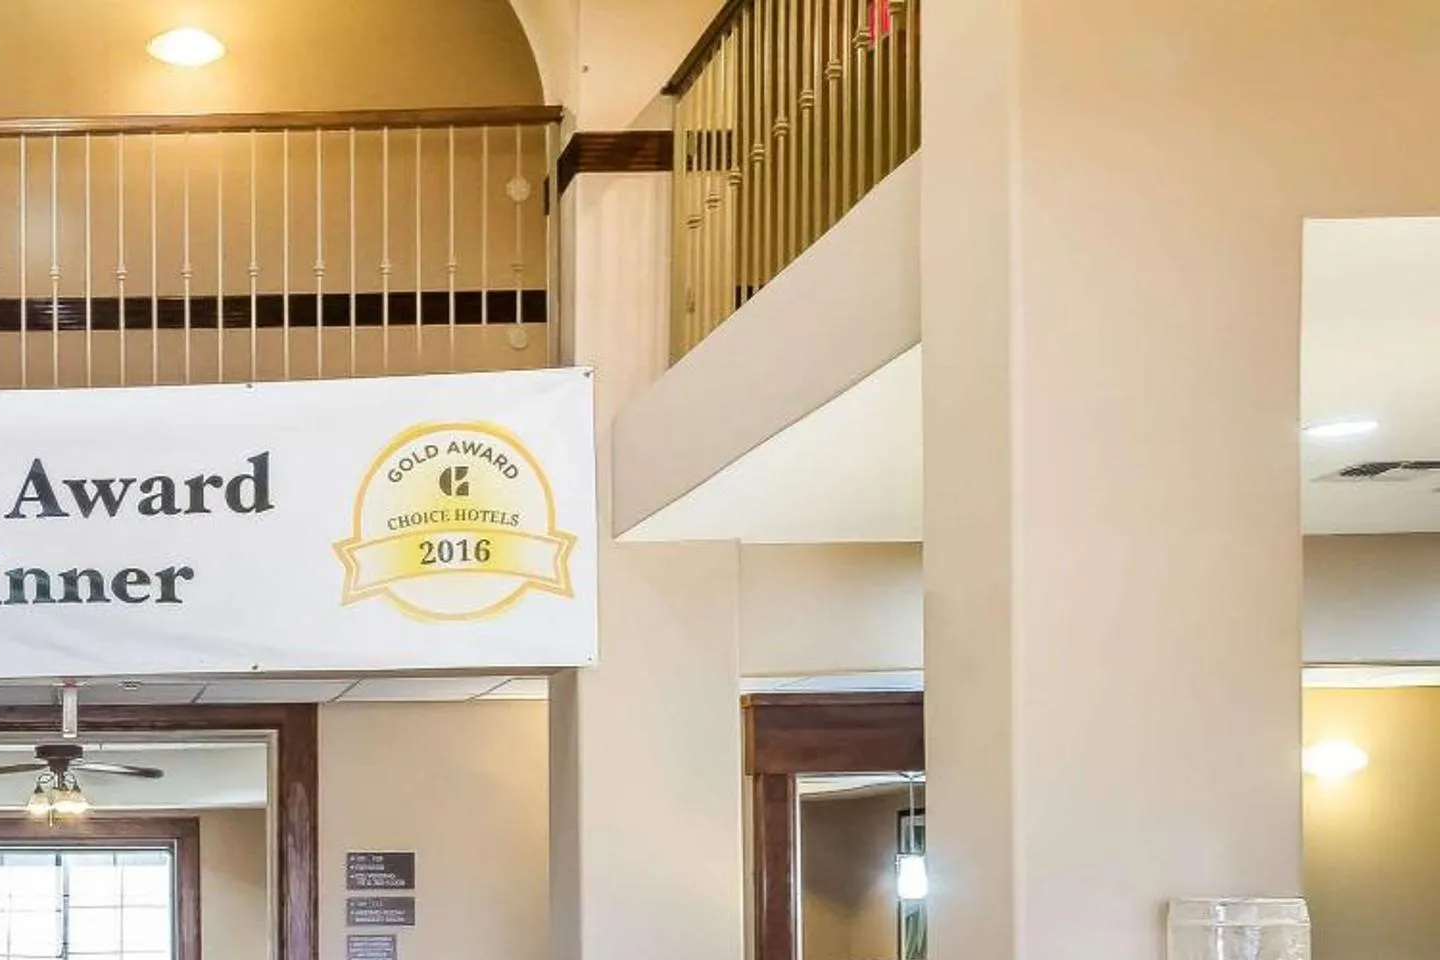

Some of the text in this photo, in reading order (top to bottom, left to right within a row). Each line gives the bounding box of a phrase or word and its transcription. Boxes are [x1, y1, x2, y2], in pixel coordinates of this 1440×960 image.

[388, 441, 519, 483] GOLD AWARD
[4, 451, 275, 520] Award
[388, 508, 520, 531] CHOICE HOTELS
[419, 539, 491, 565] 2016
